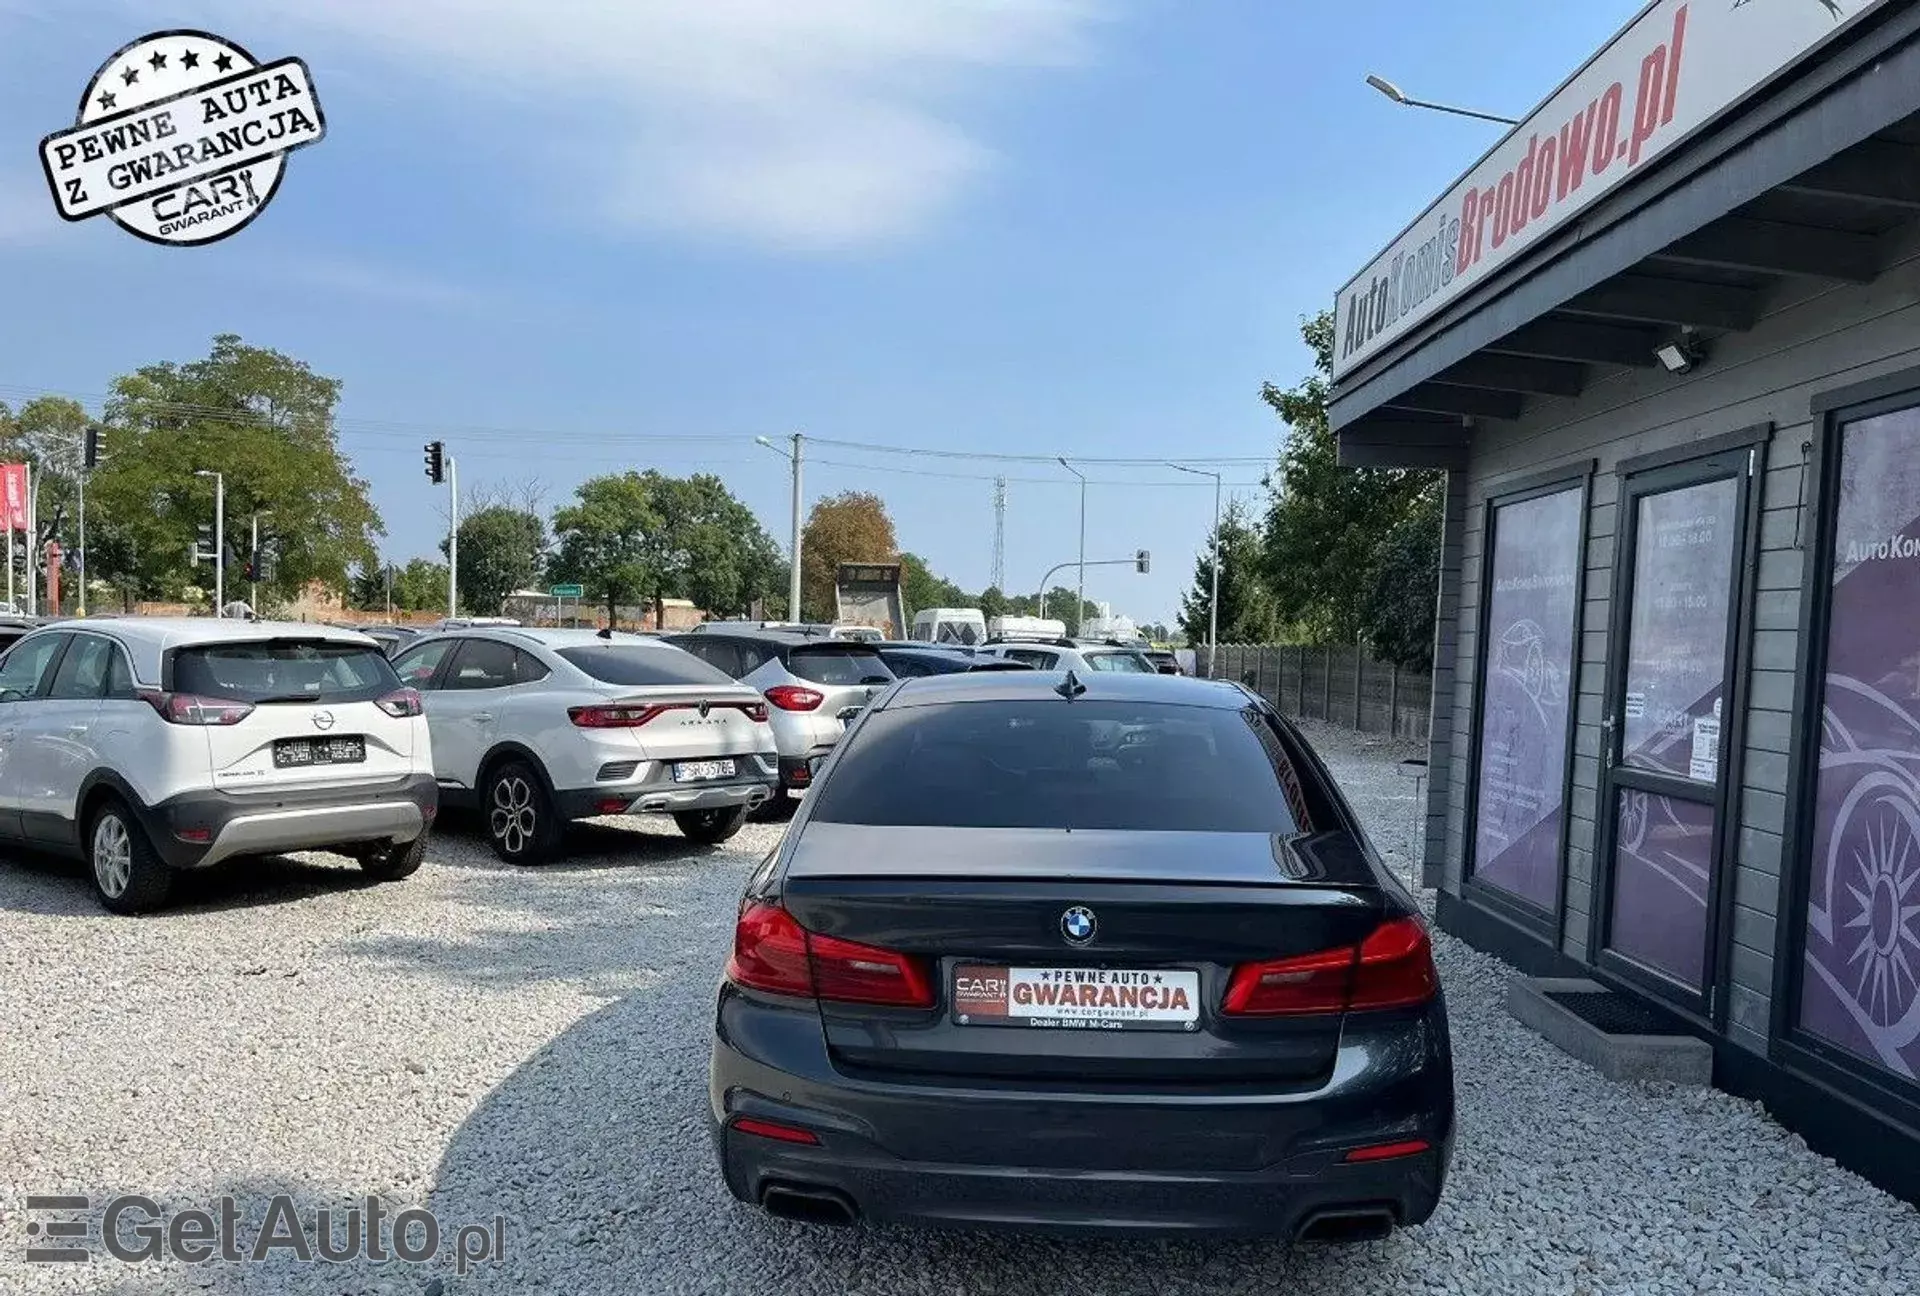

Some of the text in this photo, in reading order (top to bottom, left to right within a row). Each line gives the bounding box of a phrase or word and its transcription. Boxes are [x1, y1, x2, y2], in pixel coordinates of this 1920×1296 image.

[956, 977, 999, 992] CAR
[1054, 970, 1150, 985] PEWNE AUTO
[1013, 982, 1190, 1010] GWARANCJA
[1030, 1018, 1060, 1027] Dealer
[1062, 1019, 1086, 1028] BMW
